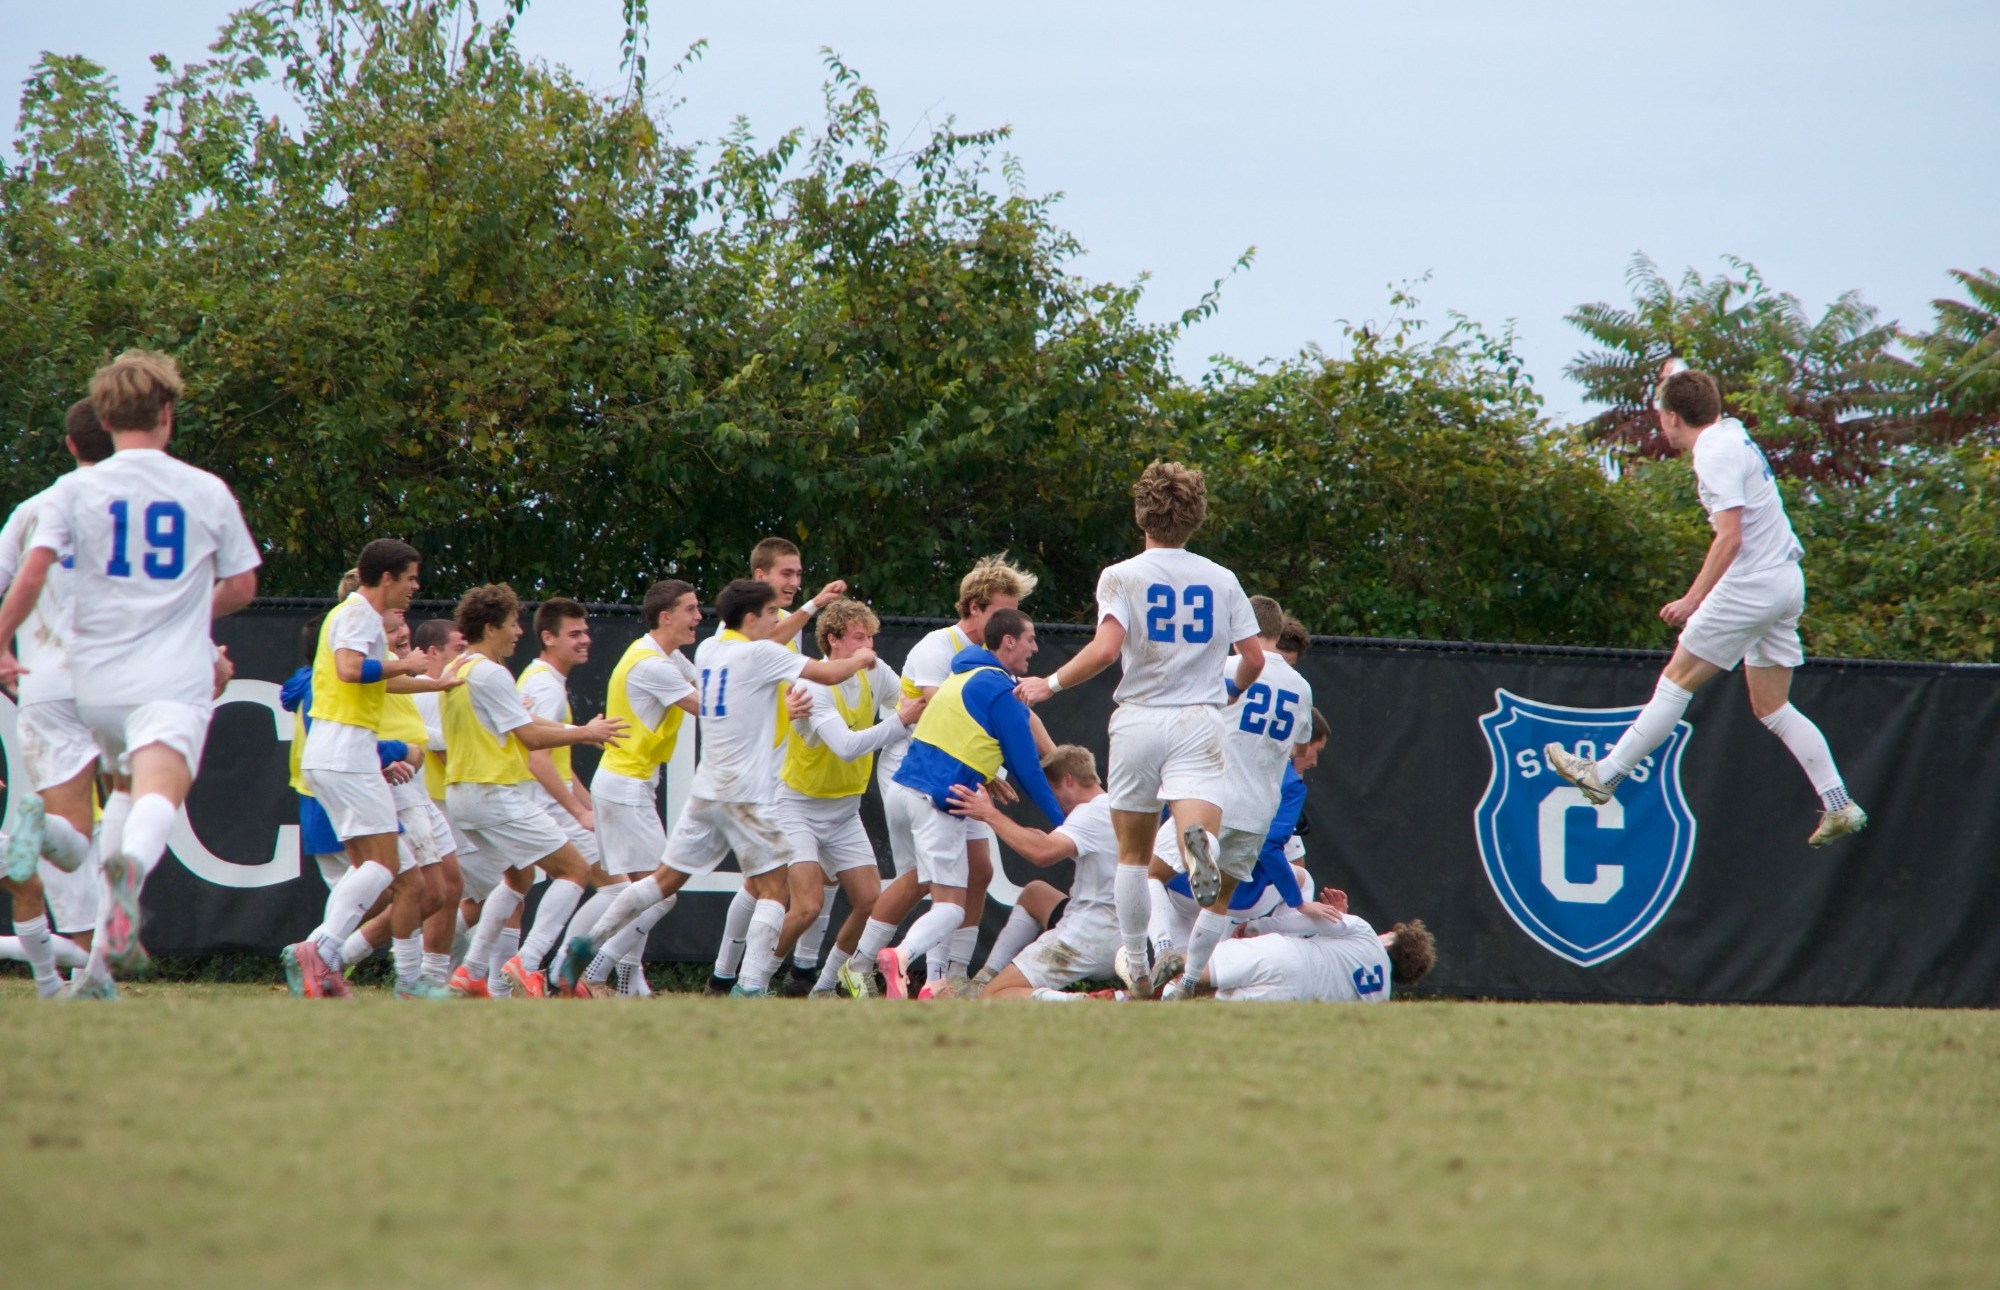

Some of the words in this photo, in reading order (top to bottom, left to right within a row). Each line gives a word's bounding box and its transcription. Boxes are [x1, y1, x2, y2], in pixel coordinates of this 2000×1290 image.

[106, 499, 186, 580] 19
[1146, 583, 1214, 644] 23
[701, 667, 729, 717] 11
[1239, 682, 1300, 742] 25
[1516, 739, 1655, 783] SOS
[1538, 786, 1625, 905] C
[1352, 964, 1384, 995] 3
